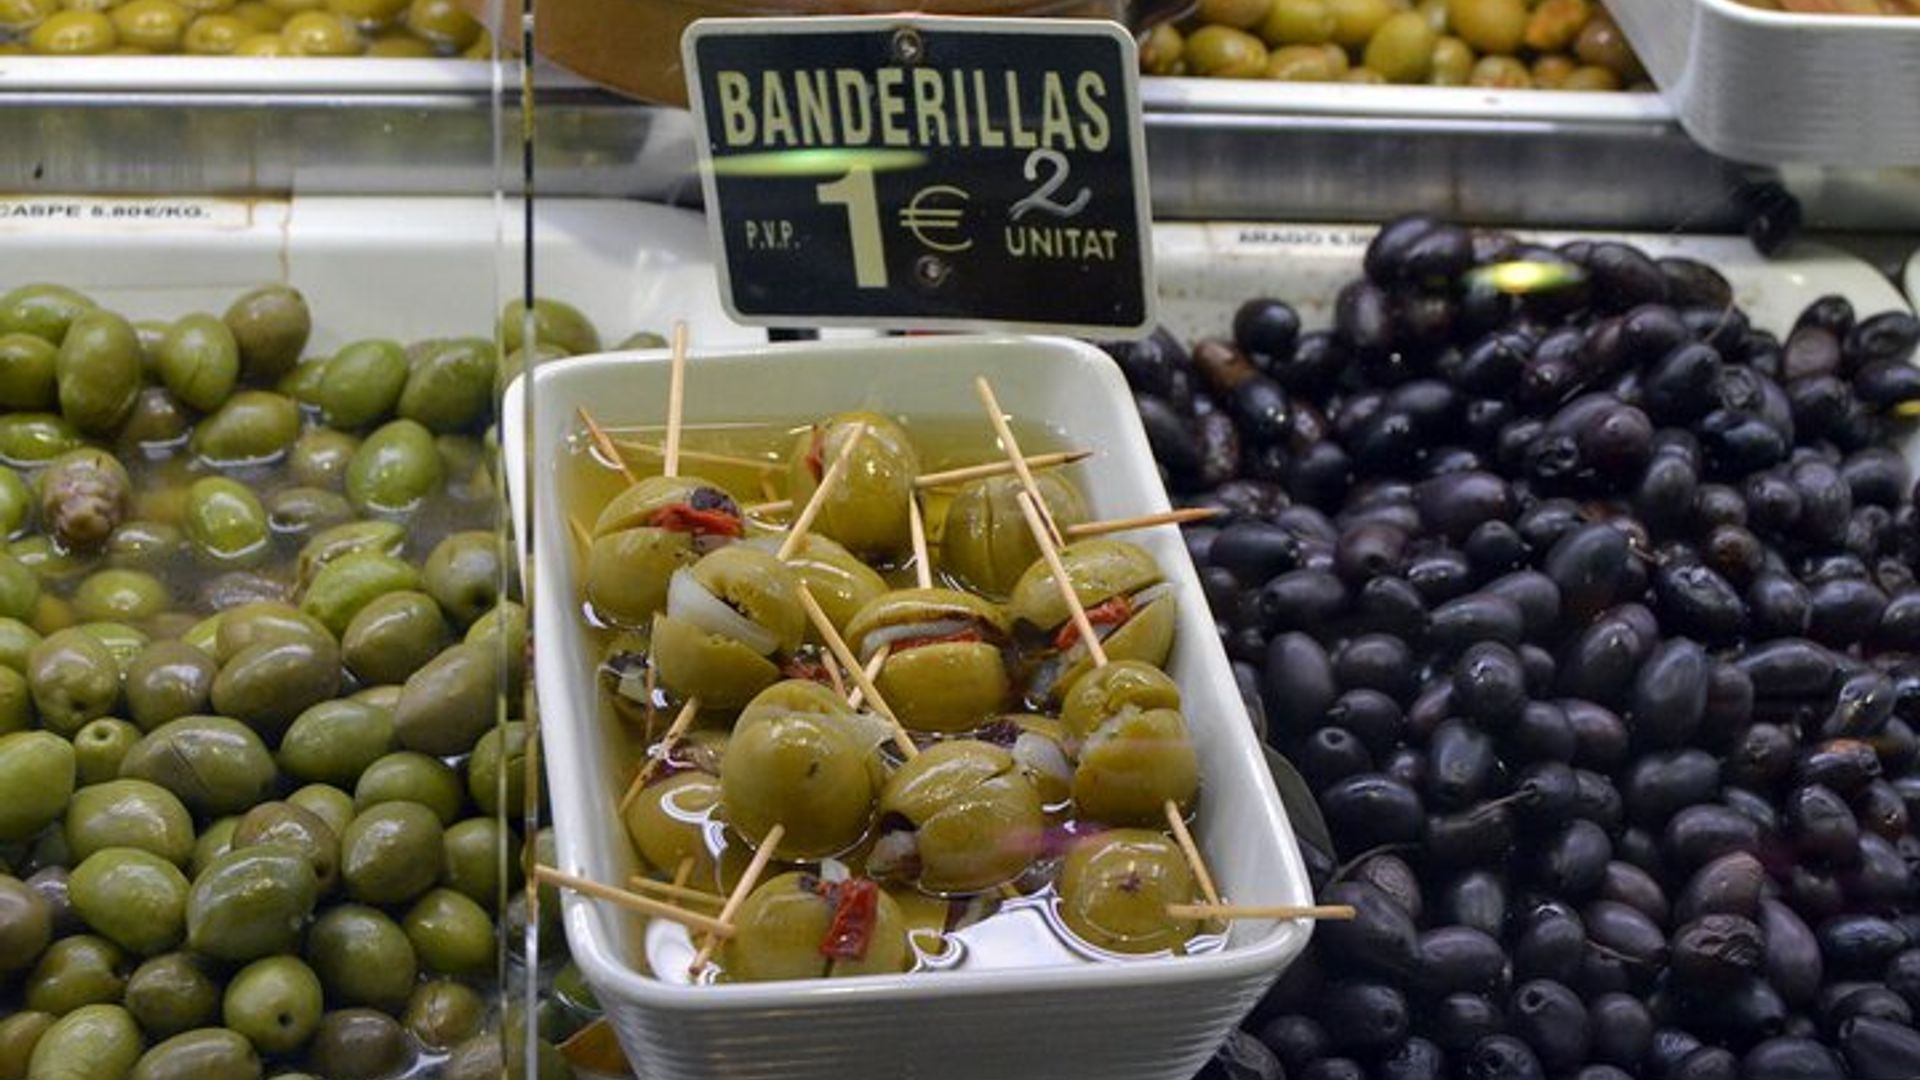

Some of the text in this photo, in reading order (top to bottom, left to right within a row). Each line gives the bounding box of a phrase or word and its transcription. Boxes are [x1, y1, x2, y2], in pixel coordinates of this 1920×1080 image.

[718, 68, 1110, 152] BANDERILLAS
[1009, 148, 1092, 221] 2
[745, 164, 973, 289] P.V.P. 1 €
[1005, 226, 1119, 261] UNITAT
